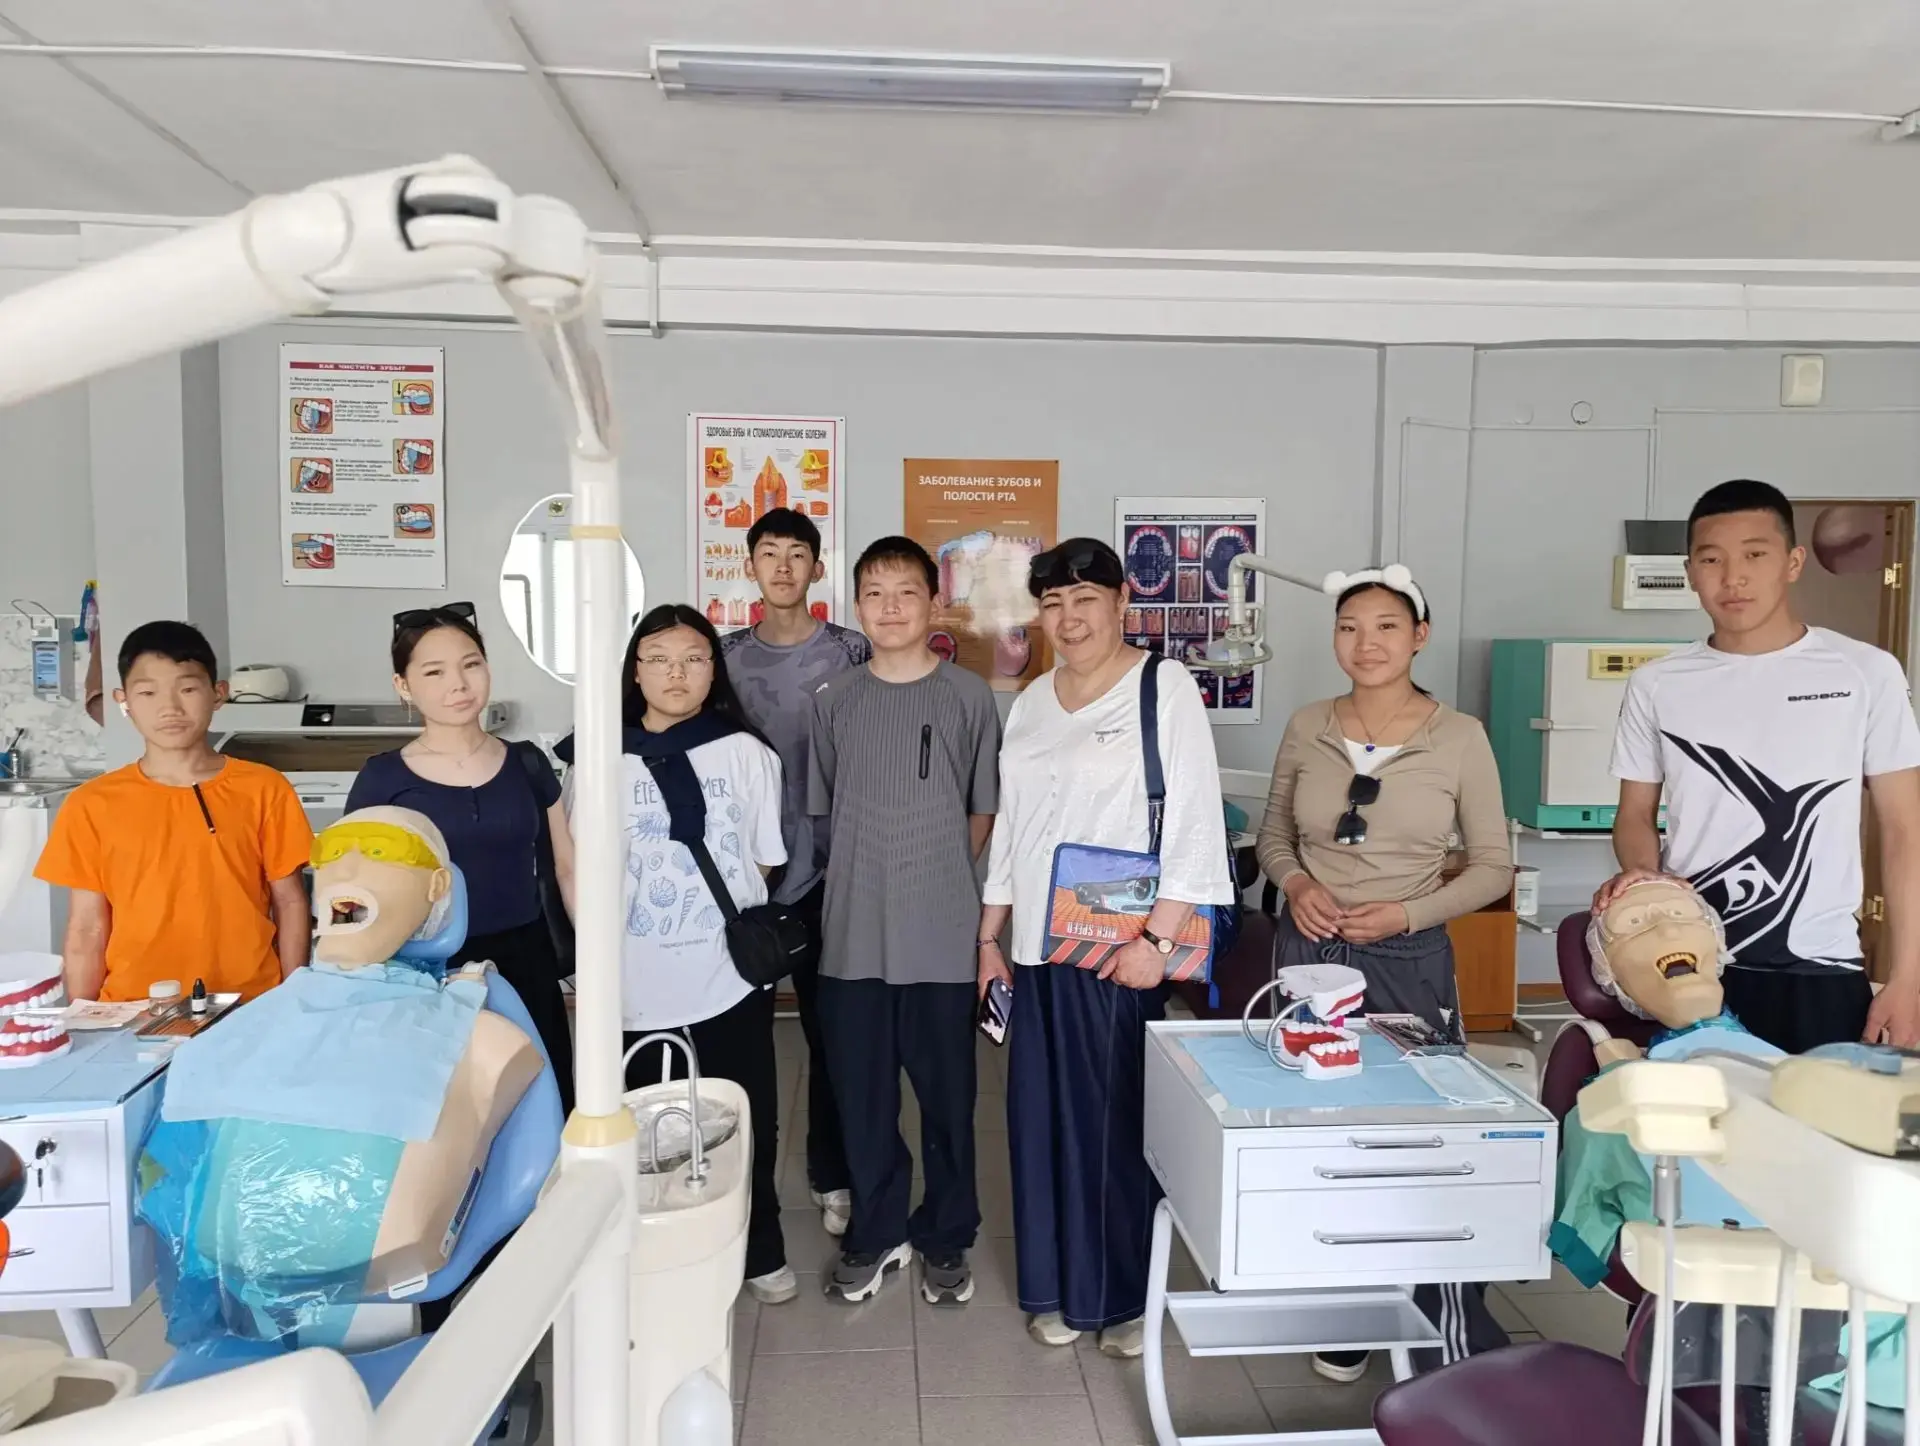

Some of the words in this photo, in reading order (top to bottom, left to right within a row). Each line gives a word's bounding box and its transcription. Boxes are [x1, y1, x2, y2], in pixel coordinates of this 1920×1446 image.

[706, 426, 732, 437] ЗДОРОВЫЕ
[732, 427, 746, 437] ЗУБЫ
[752, 427, 804, 439] СТОМАТОЛОГИЧЕСКИЕ
[805, 429, 827, 439] БОЛЕЗНИ
[919, 475, 995, 486] ЗАБОЛЕВАНИЕ
[997, 477, 1031, 487] ЗУБОВ
[1033, 478, 1041, 487] И
[943, 490, 995, 501] ПОЛОСТИ
[997, 491, 1017, 502] РТА
